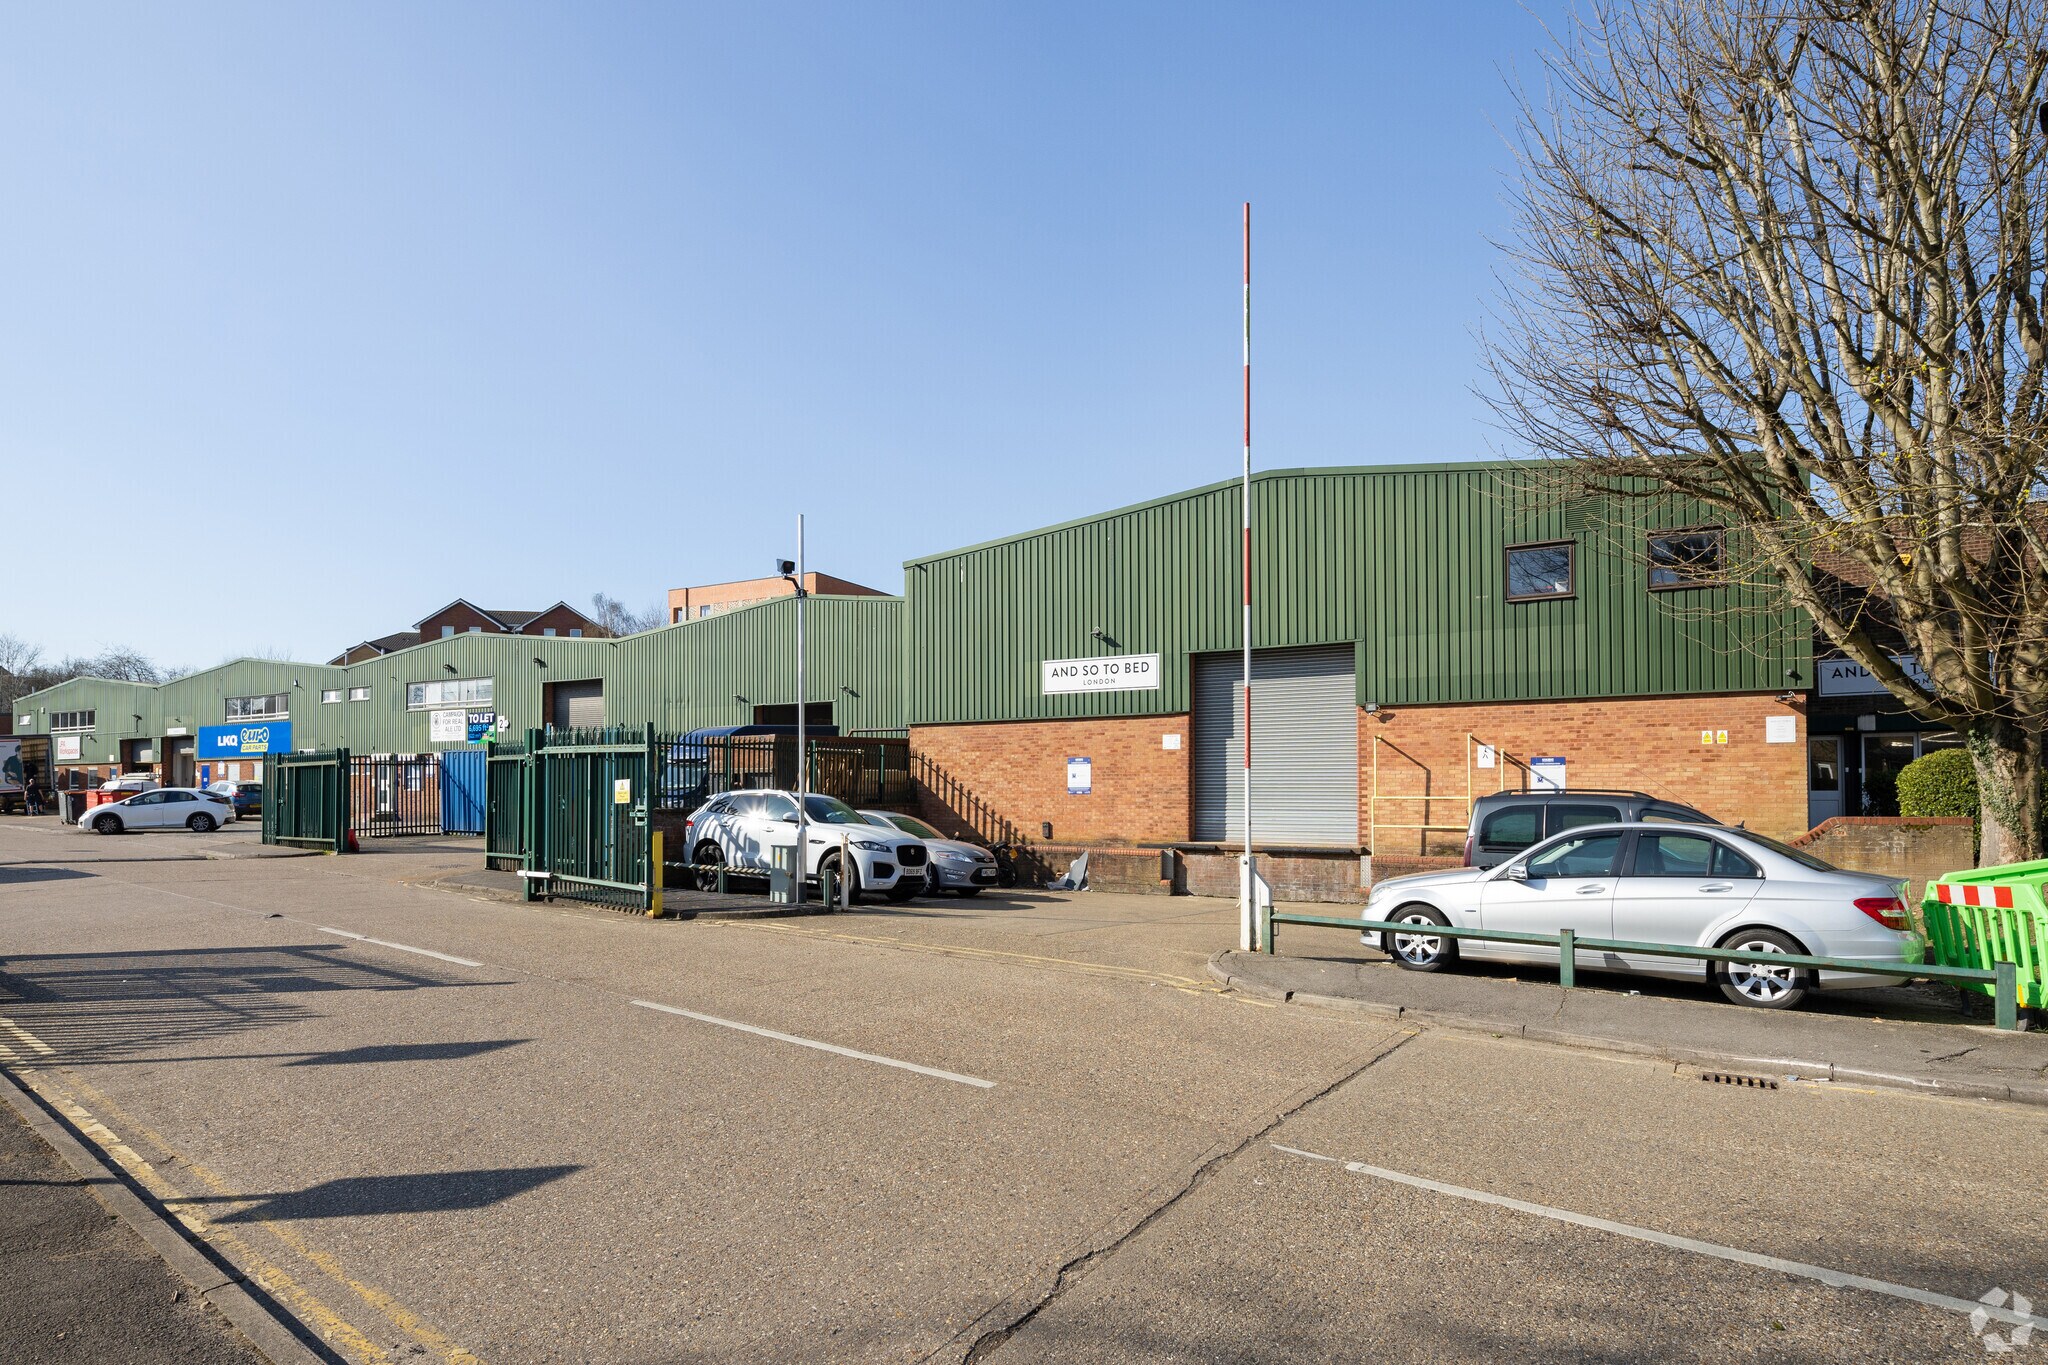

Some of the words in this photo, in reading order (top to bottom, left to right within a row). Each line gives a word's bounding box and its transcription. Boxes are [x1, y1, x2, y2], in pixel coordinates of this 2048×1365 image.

[1051, 666, 1078, 678] AND
[1082, 665, 1099, 676] SO
[1103, 663, 1120, 675] TO
[1124, 661, 1150, 674] BED
[1831, 666, 1871, 679] AND
[1082, 678, 1116, 686] LONDON
[468, 714, 479, 723] TO
[480, 713, 494, 723] LET
[499, 719, 504, 728] 2
[217, 734, 238, 747] LKQ
[241, 726, 269, 743] euro
